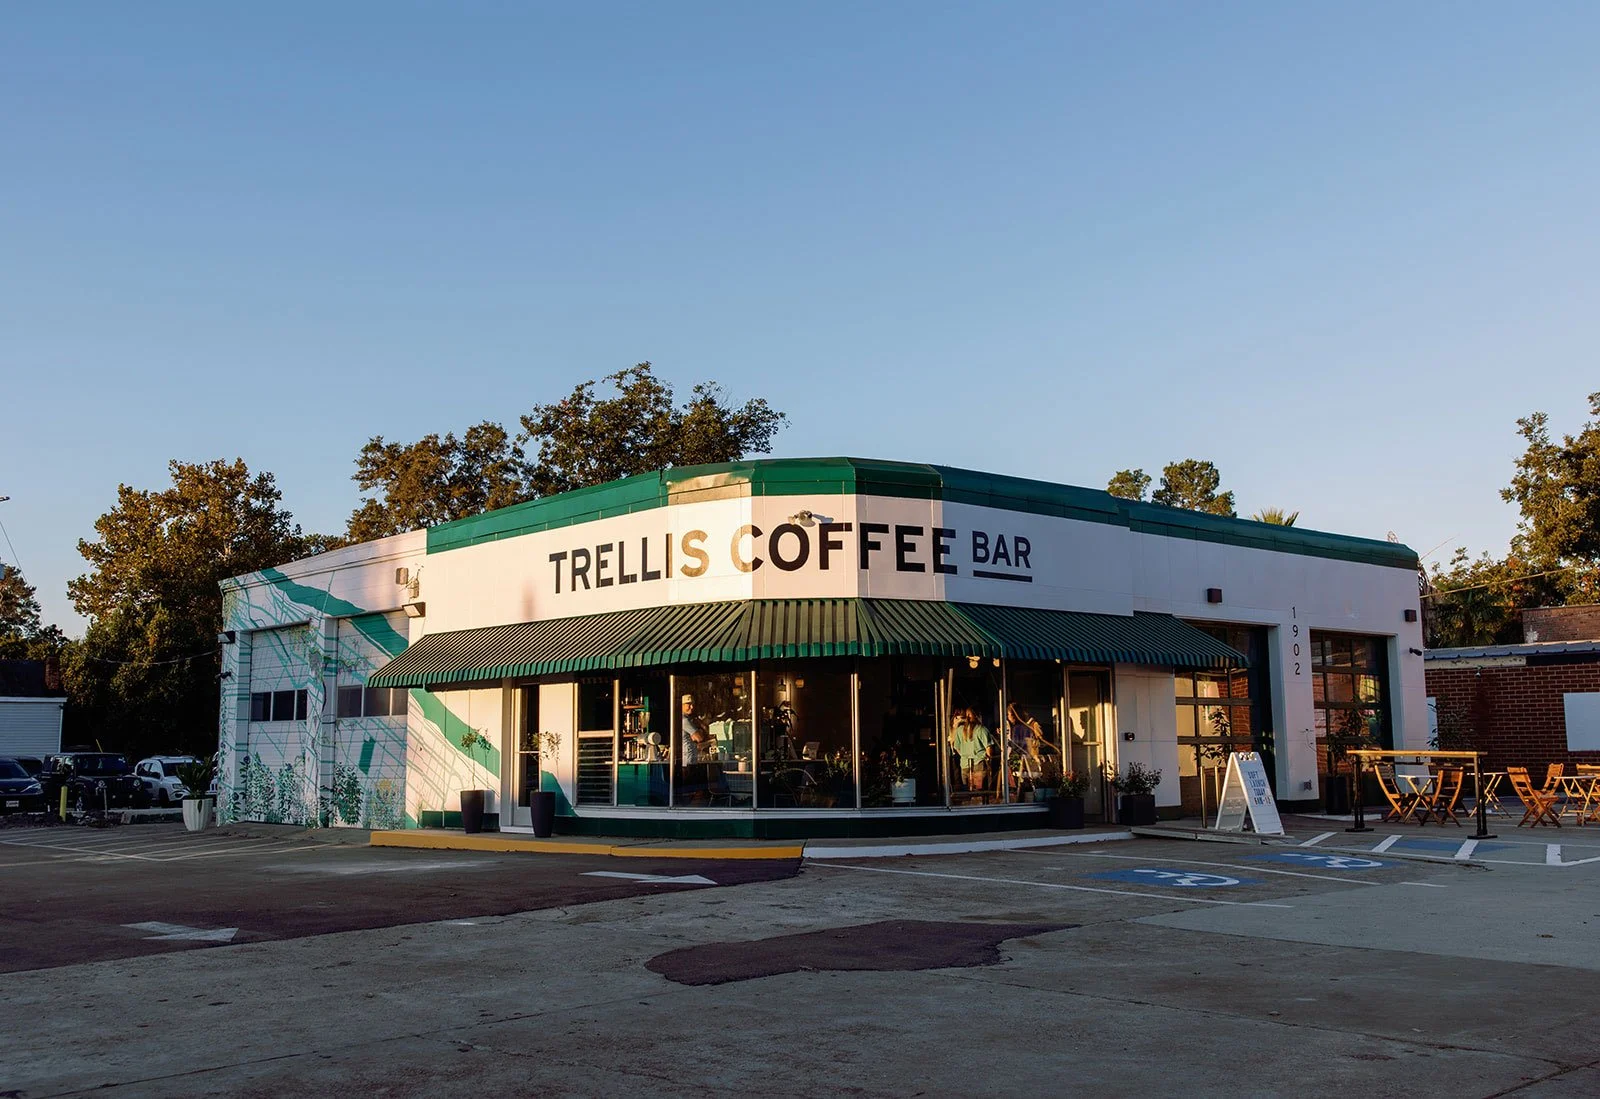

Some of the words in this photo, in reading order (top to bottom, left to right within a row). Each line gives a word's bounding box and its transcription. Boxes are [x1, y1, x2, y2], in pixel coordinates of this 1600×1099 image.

[549, 530, 709, 594] TRELLIS
[731, 522, 958, 575] COFFEE
[973, 531, 1032, 569] BAR
[1292, 606, 1300, 675] 1902
